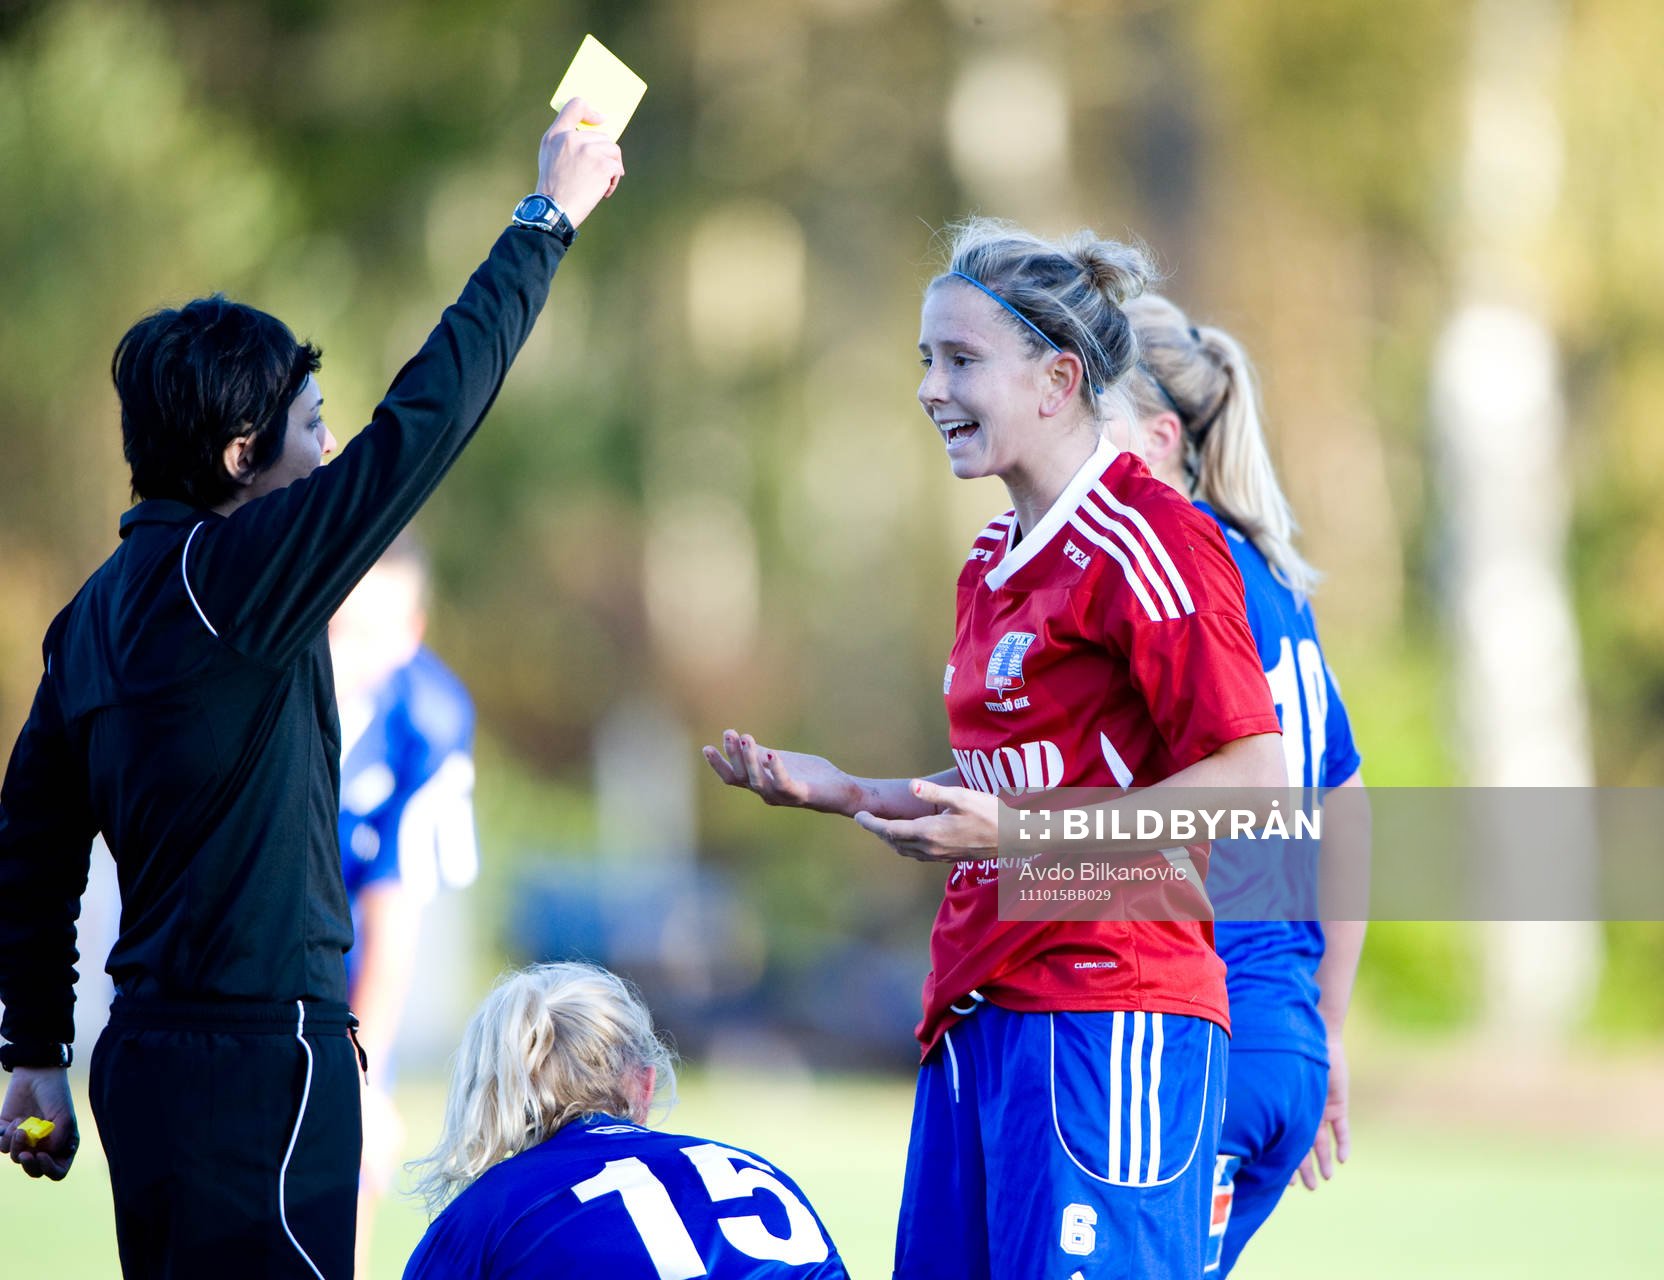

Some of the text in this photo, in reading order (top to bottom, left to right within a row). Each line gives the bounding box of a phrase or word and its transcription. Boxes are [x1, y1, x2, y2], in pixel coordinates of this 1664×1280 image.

[1013, 696, 1031, 709] GIK
[570, 1143, 829, 1280] 15
[1060, 1203, 1098, 1256] 6
